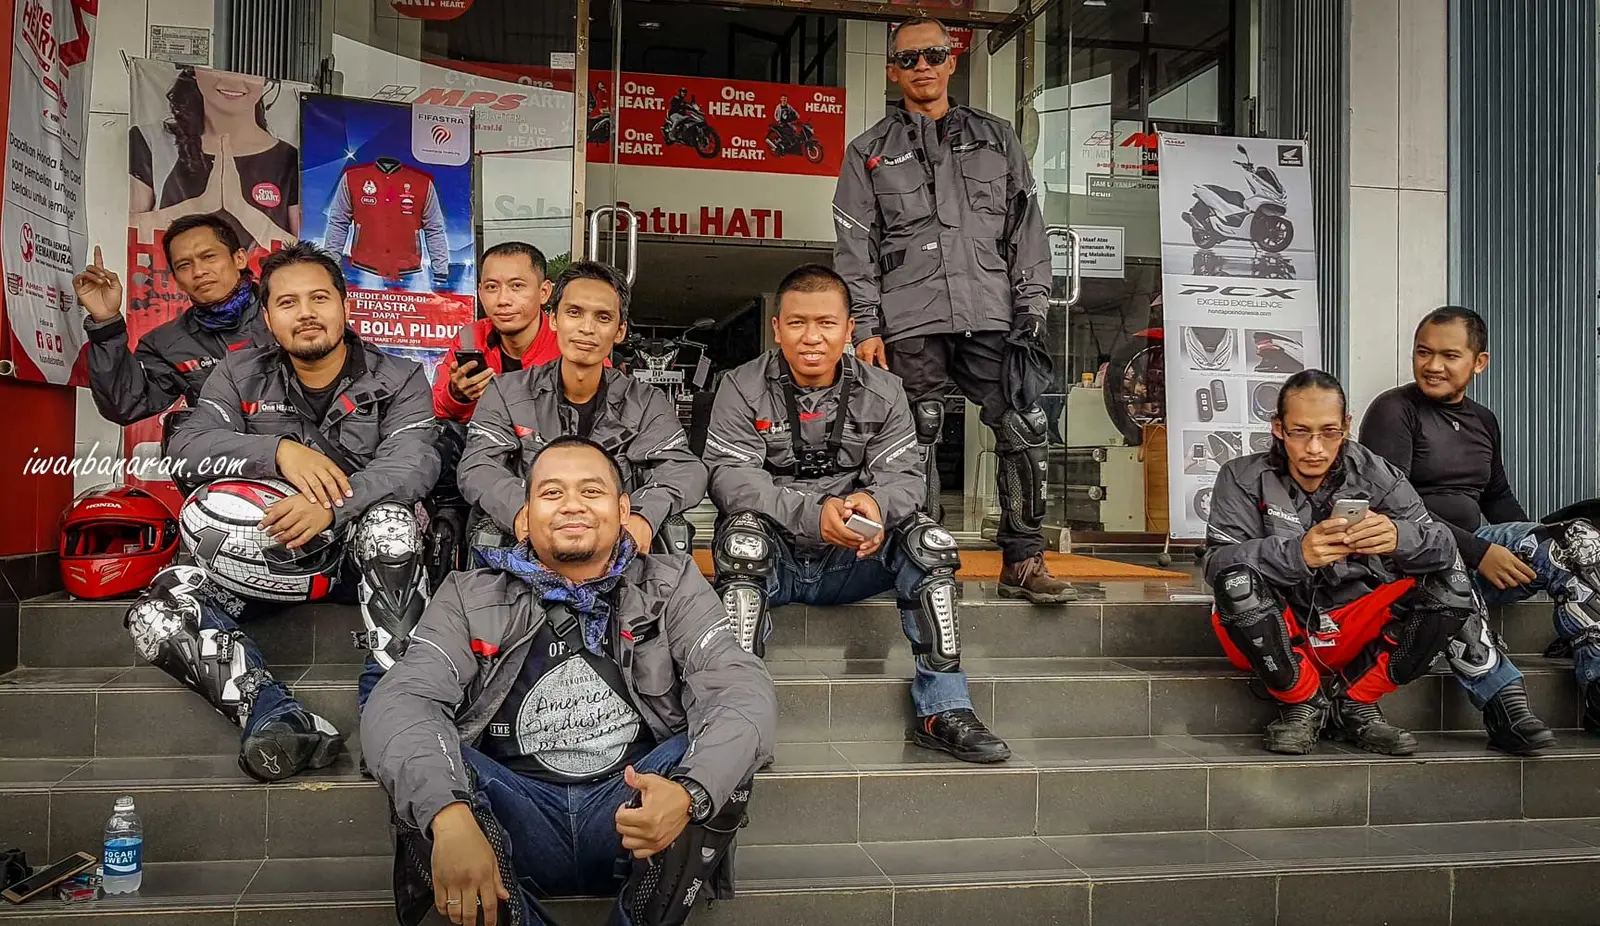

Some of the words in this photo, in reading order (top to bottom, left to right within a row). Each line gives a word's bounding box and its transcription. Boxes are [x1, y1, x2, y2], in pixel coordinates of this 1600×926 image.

[624, 81, 655, 96] One
[721, 86, 755, 101] One
[414, 87, 527, 111] MPS
[813, 92, 836, 103] One
[708, 101, 766, 118] HEART.
[805, 102, 843, 114] HEART.
[418, 113, 464, 124] FIFASTRA
[518, 123, 547, 135] One
[624, 128, 654, 141] One
[9, 133, 36, 161] Dapatkan
[731, 136, 757, 148] One
[721, 147, 765, 160] HEART.
[1092, 180, 1106, 188] JAM
[616, 201, 687, 234] Satu
[700, 206, 783, 239] HATI
[346, 291, 380, 301] KREDIT
[1178, 284, 1301, 300] PCX
[356, 300, 417, 313] FIFASTRA
[1197, 298, 1230, 306] EXCEED
[1230, 299, 1283, 309] EXCELLENCE
[372, 311, 401, 320] DAPAT
[360, 320, 405, 337] BOLA
[409, 323, 463, 339] PILDU
[261, 403, 275, 411] One
[104, 850, 136, 859] POCARI
[104, 856, 133, 864] SWEAT
